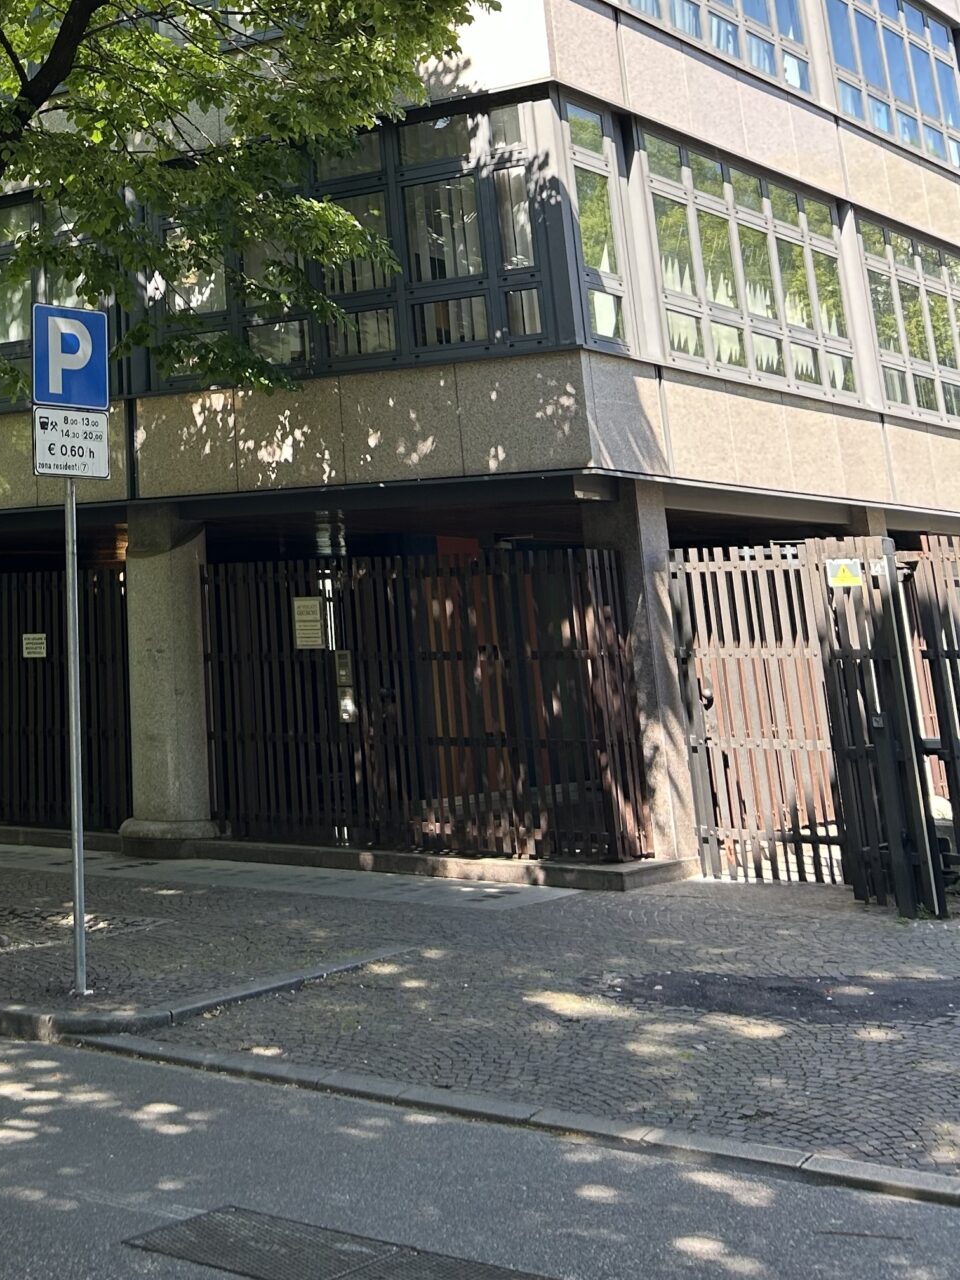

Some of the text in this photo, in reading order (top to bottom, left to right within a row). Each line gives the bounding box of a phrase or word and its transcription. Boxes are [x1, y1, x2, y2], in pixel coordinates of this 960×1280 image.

[48, 316, 92, 394] P
[38, 461, 52, 470] zona
[53, 461, 80, 472] residenti
